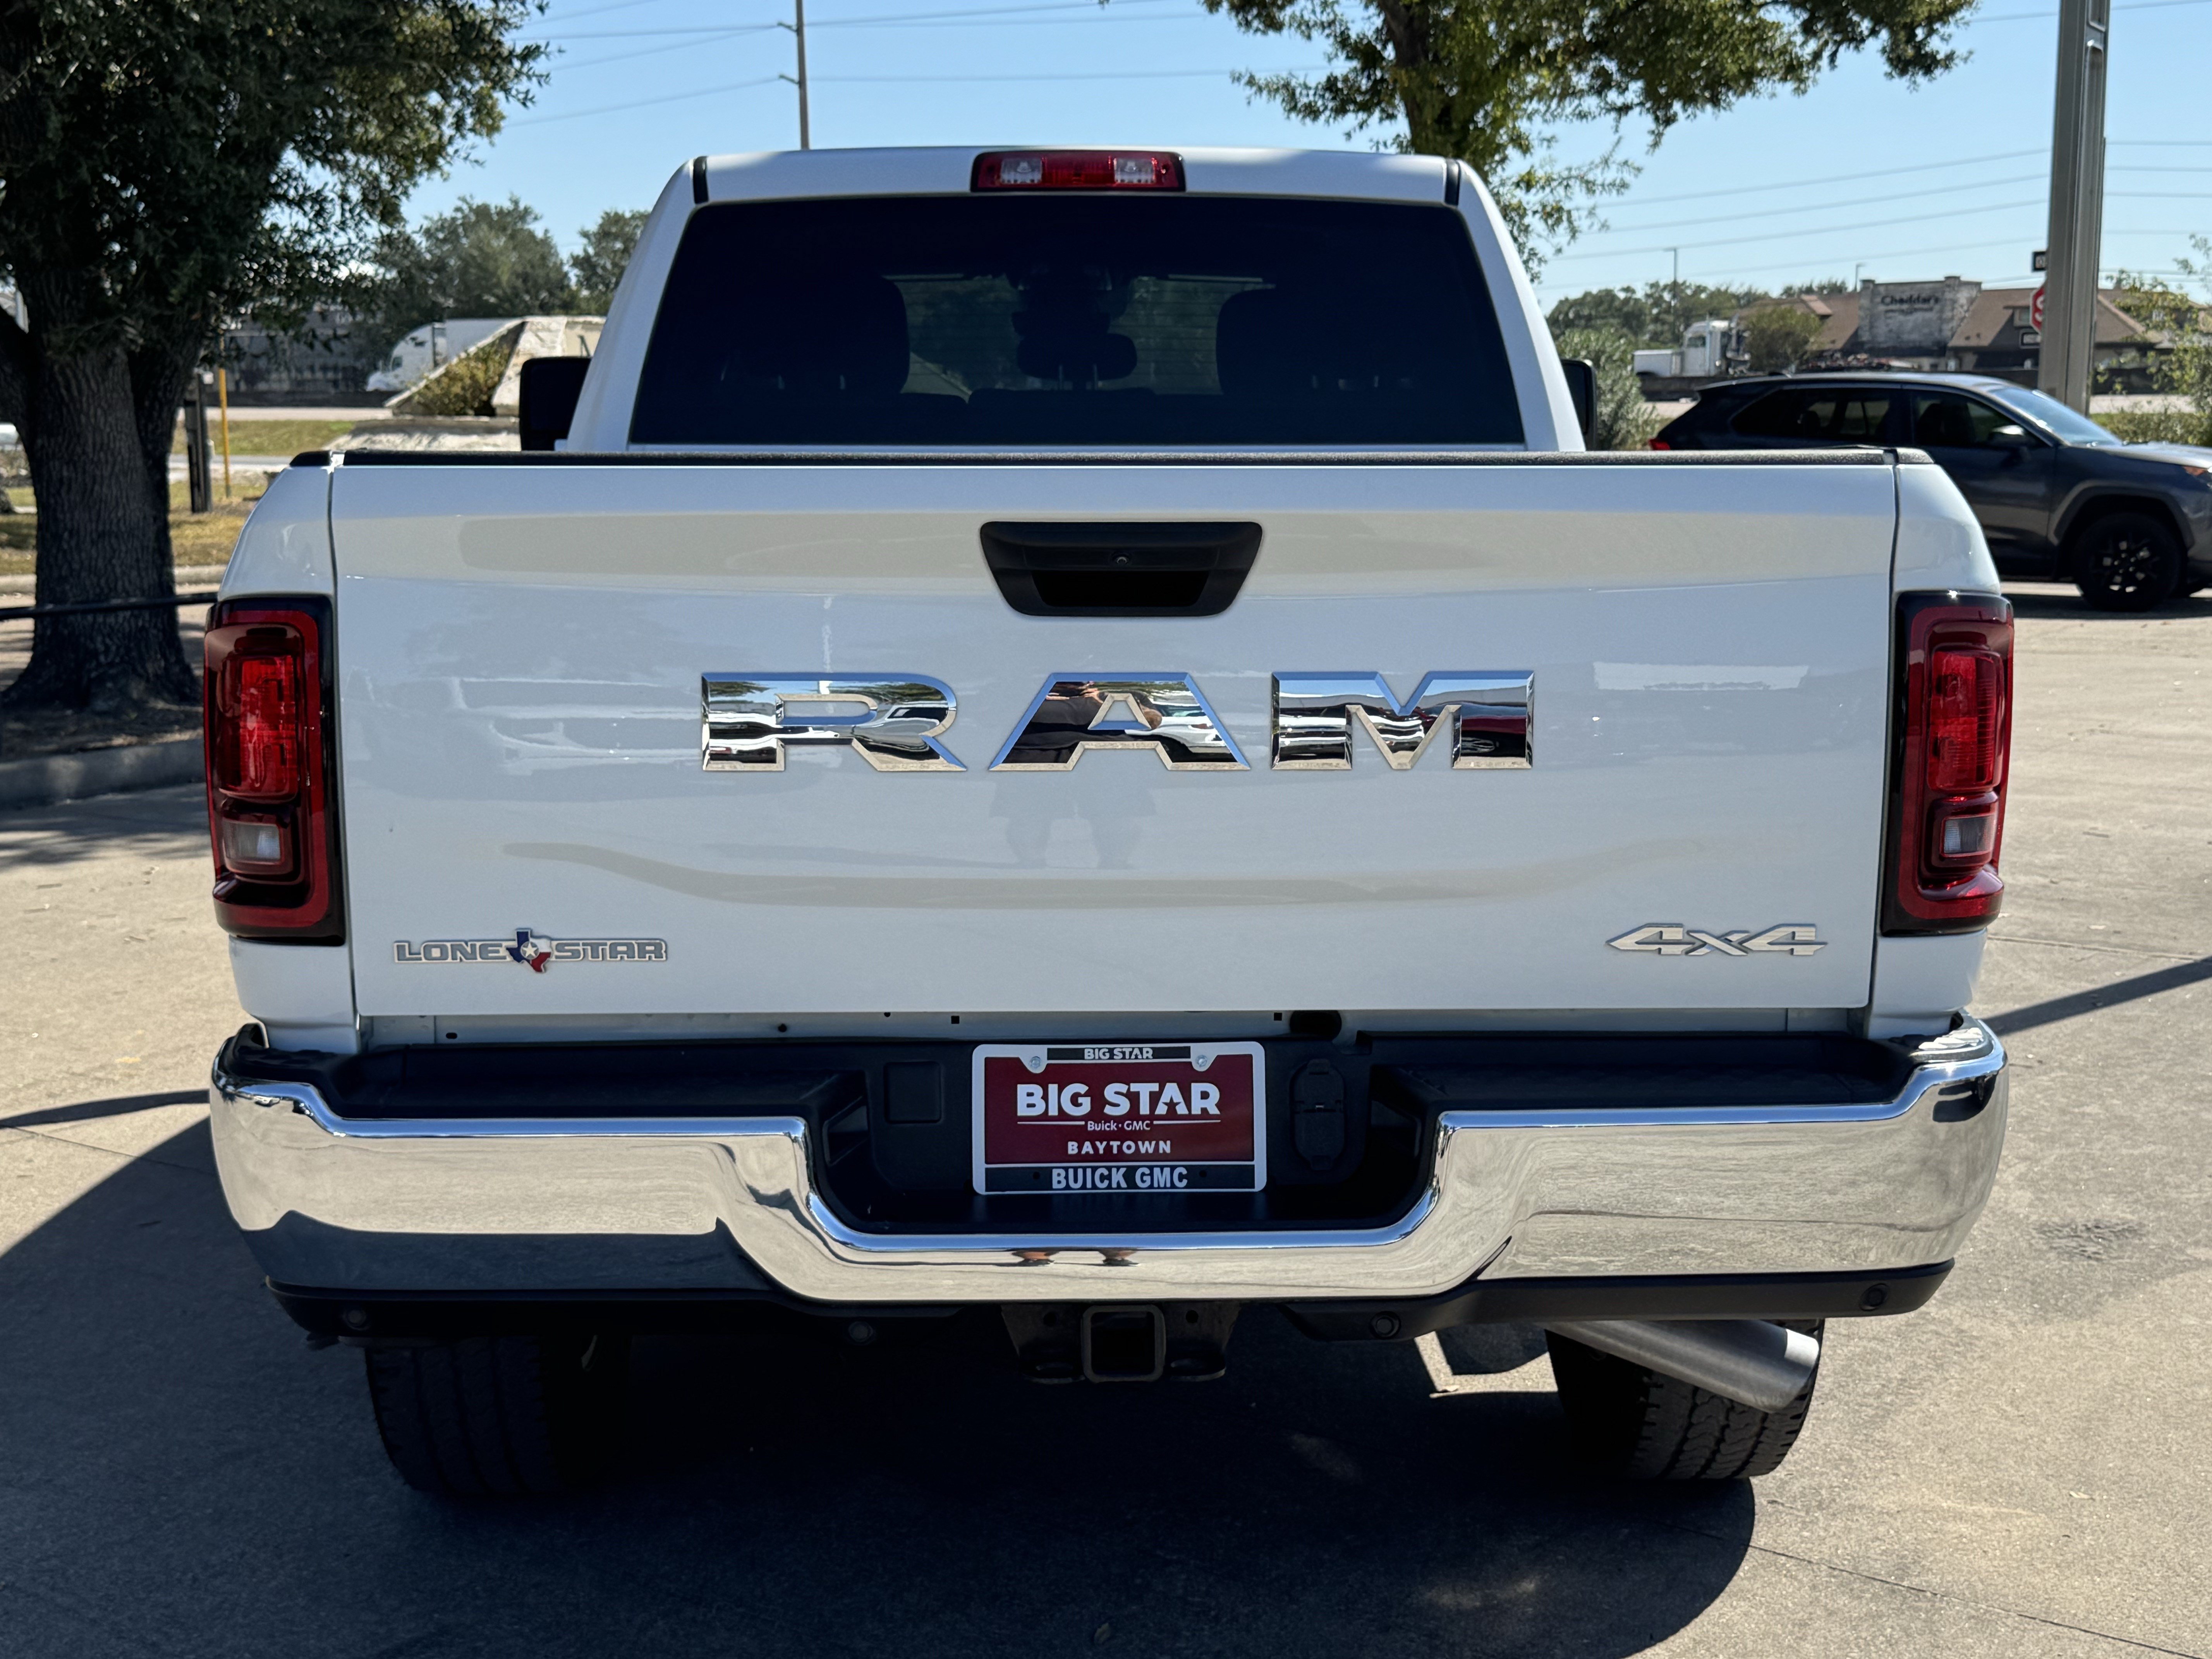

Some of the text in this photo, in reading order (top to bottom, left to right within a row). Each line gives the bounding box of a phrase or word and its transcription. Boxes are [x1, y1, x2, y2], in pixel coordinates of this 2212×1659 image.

[702, 671, 1534, 772] RAM
[394, 939, 668, 962] LONE STAR
[1084, 1048, 1153, 1060] BIG STAR
[1017, 1083, 1221, 1116] BIG STAR
[1087, 1120, 1151, 1131] Buick GMC
[1068, 1140, 1171, 1155] BAYTOWN
[1052, 1167, 1188, 1189] BUICK GMC
